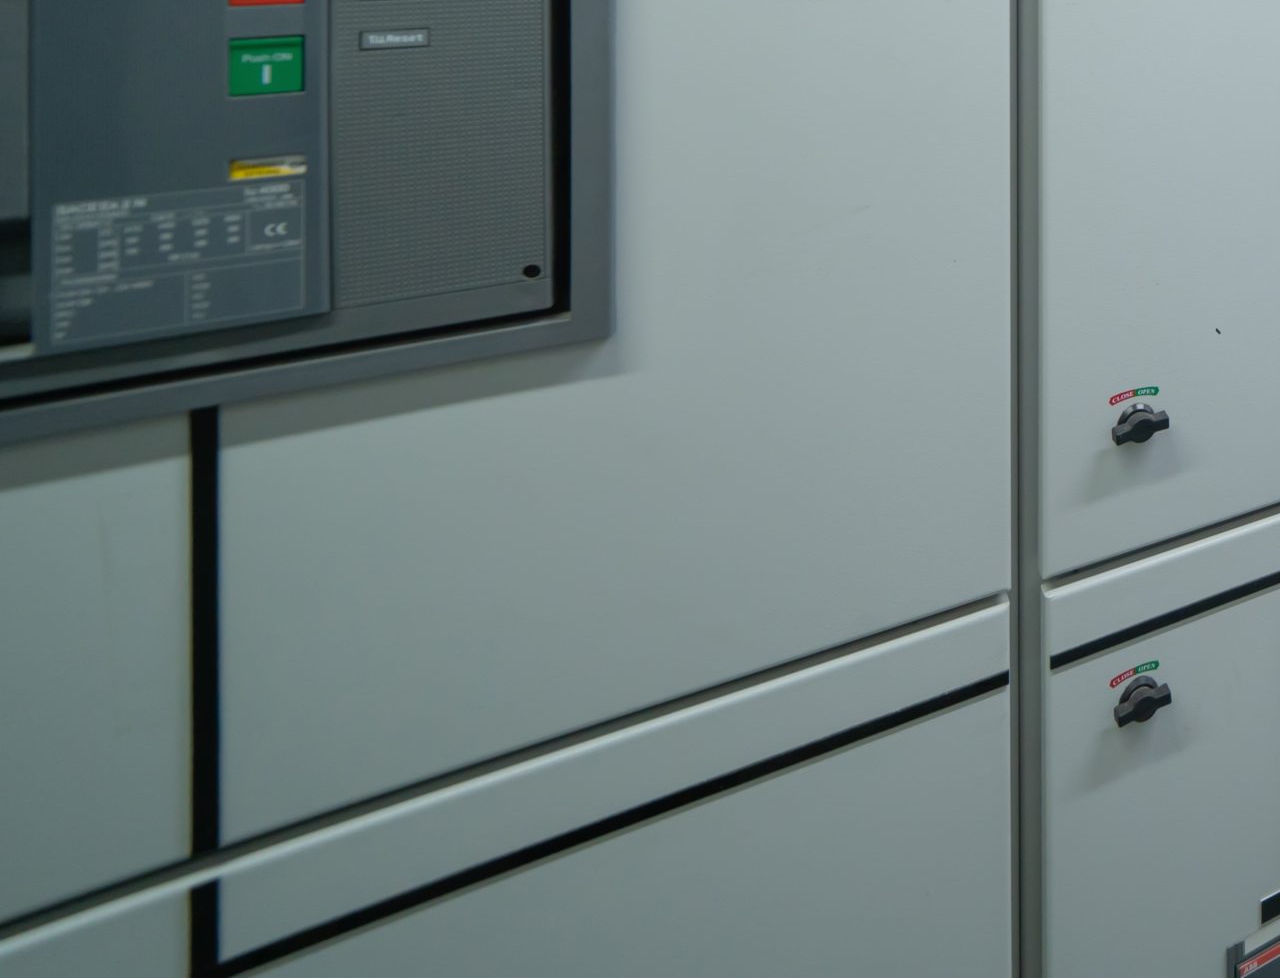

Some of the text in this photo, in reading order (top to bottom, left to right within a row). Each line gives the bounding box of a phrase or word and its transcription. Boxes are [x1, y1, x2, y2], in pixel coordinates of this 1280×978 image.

[1111, 388, 1156, 404] CLOSE OPEN
[1111, 662, 1156, 686] CLOSE OPEN
[1244, 961, 1259, 974] ABB
